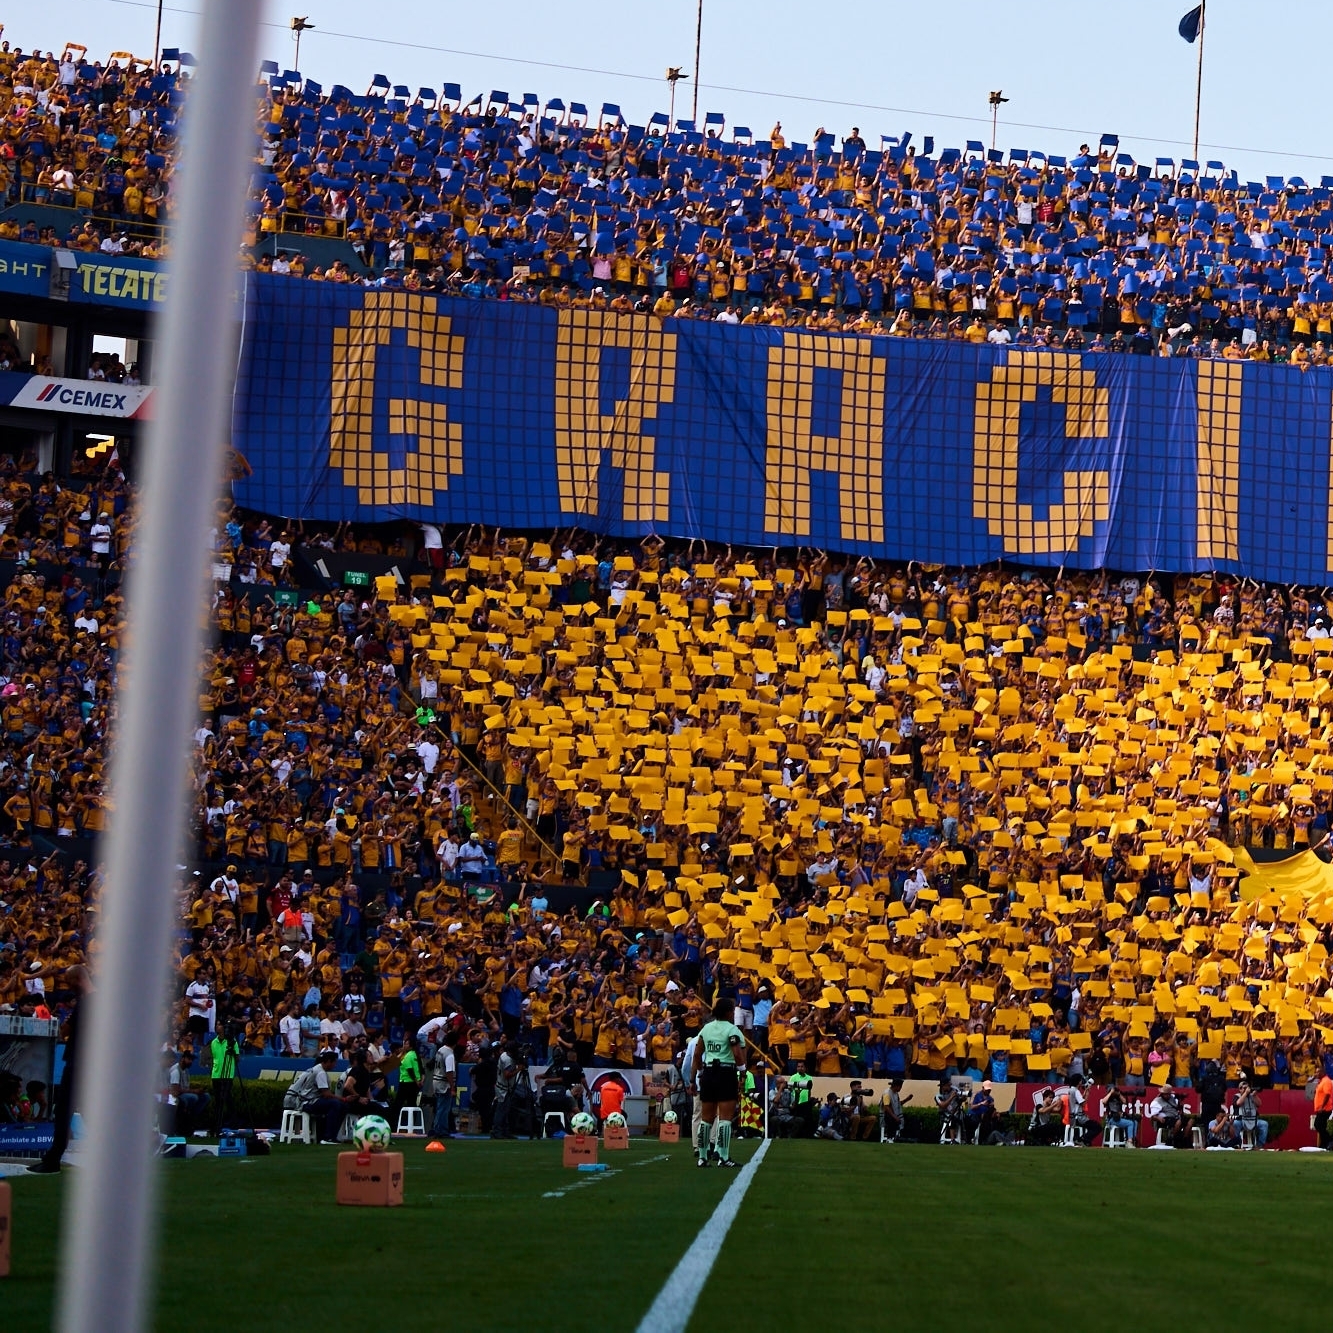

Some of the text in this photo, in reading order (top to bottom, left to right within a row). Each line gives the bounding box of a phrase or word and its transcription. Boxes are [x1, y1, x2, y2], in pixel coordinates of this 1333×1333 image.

[77, 263, 169, 302] TECATE
[59, 388, 127, 410] CEMEX
[351, 577, 362, 585] 19
